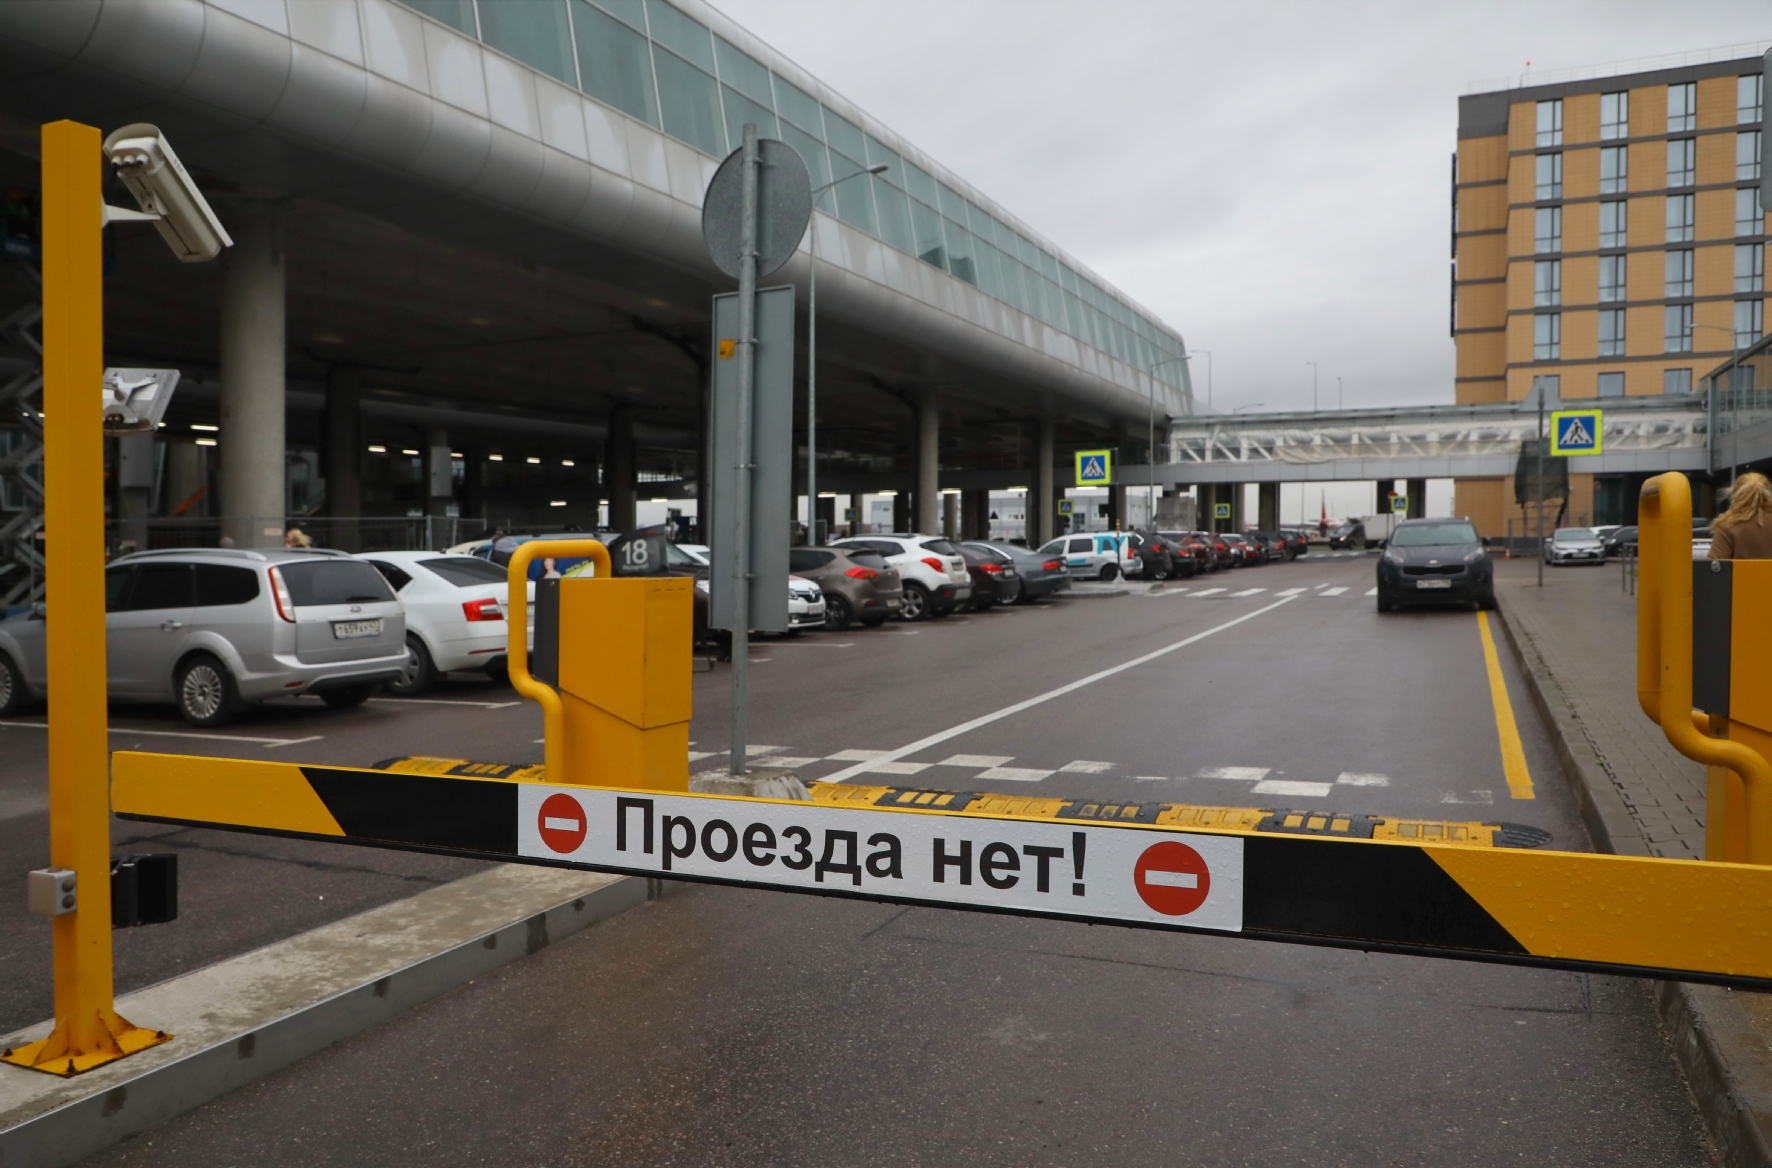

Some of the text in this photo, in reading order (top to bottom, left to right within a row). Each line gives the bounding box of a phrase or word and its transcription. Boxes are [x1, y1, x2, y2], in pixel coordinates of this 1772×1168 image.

[621, 539, 648, 565] 18
[616, 796, 1087, 897] Проезда нет!
